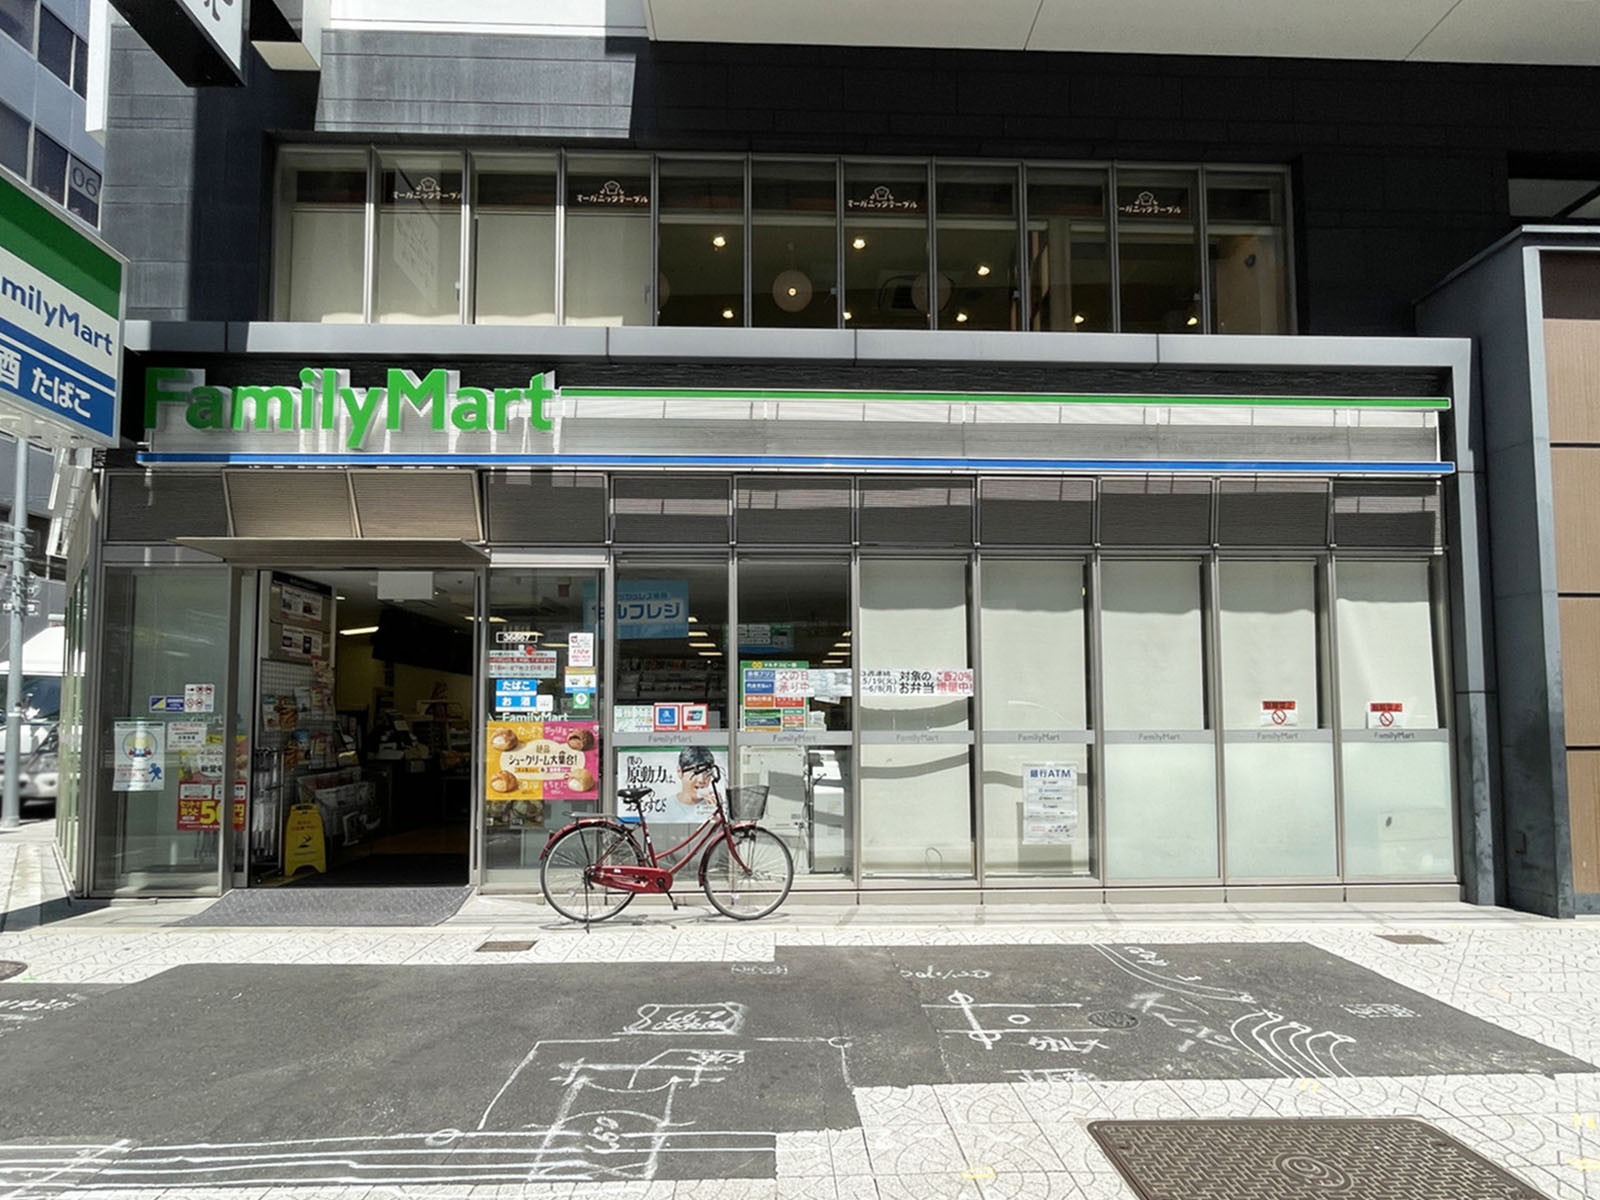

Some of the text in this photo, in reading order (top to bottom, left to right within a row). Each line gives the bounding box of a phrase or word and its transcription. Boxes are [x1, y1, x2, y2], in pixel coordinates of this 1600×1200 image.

[72, 166, 98, 198] 06
[32, 366, 91, 418] たばこ
[144, 367, 555, 449] FamilyMart
[780, 671, 808, 680] 父の日
[900, 670, 931, 681] 対象の
[502, 680, 531, 690] たばこ
[900, 682, 934, 694] お弁当
[502, 712, 569, 721] FamilyMart
[648, 735, 692, 744] FamilyMart
[773, 734, 816, 743] FamilyMart
[1018, 733, 1060, 742] FamilyMart
[1138, 732, 1181, 742] FamilyMart
[1257, 732, 1298, 741] FamilyMart
[1374, 732, 1414, 741] FamilyMart
